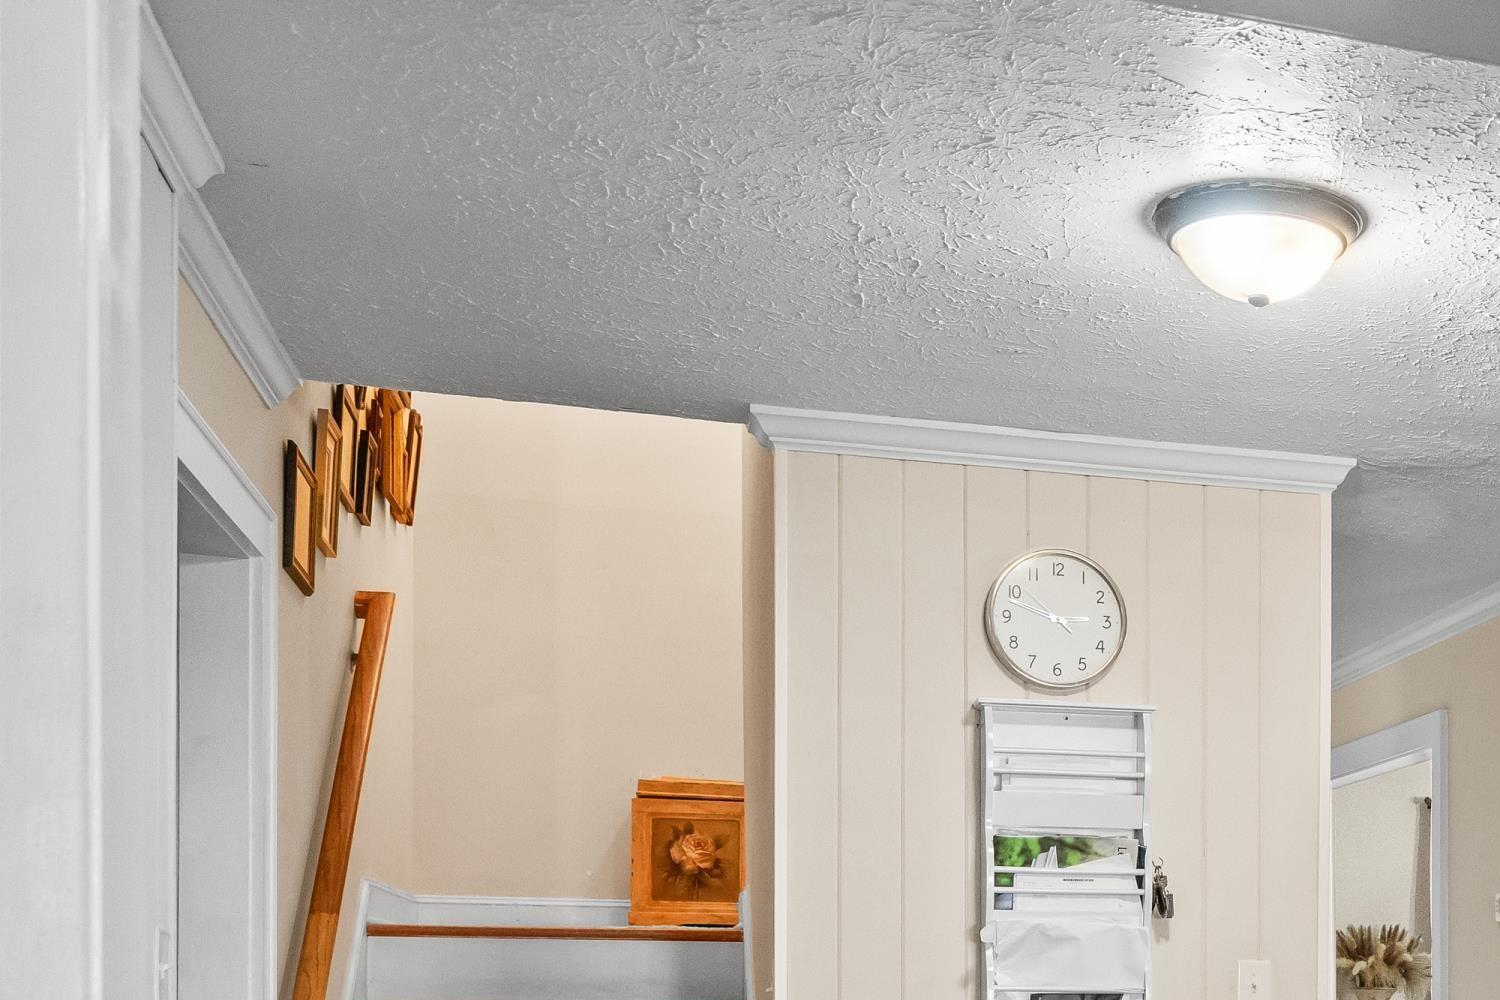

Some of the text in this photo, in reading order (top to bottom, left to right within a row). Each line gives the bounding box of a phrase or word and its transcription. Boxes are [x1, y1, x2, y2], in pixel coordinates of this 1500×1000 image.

[1028, 567, 1039, 582] 11
[1052, 562, 1065, 577] 12
[1008, 584, 1022, 599] 10
[1095, 590, 1105, 604] 2
[1002, 609, 1012, 624] 9
[1102, 615, 1112, 629] 3
[1008, 635, 1019, 649] 8
[1095, 640, 1106, 654] 4
[1028, 654, 1037, 669] 7
[1077, 657, 1087, 671] 5
[1052, 662, 1062, 677] 6
